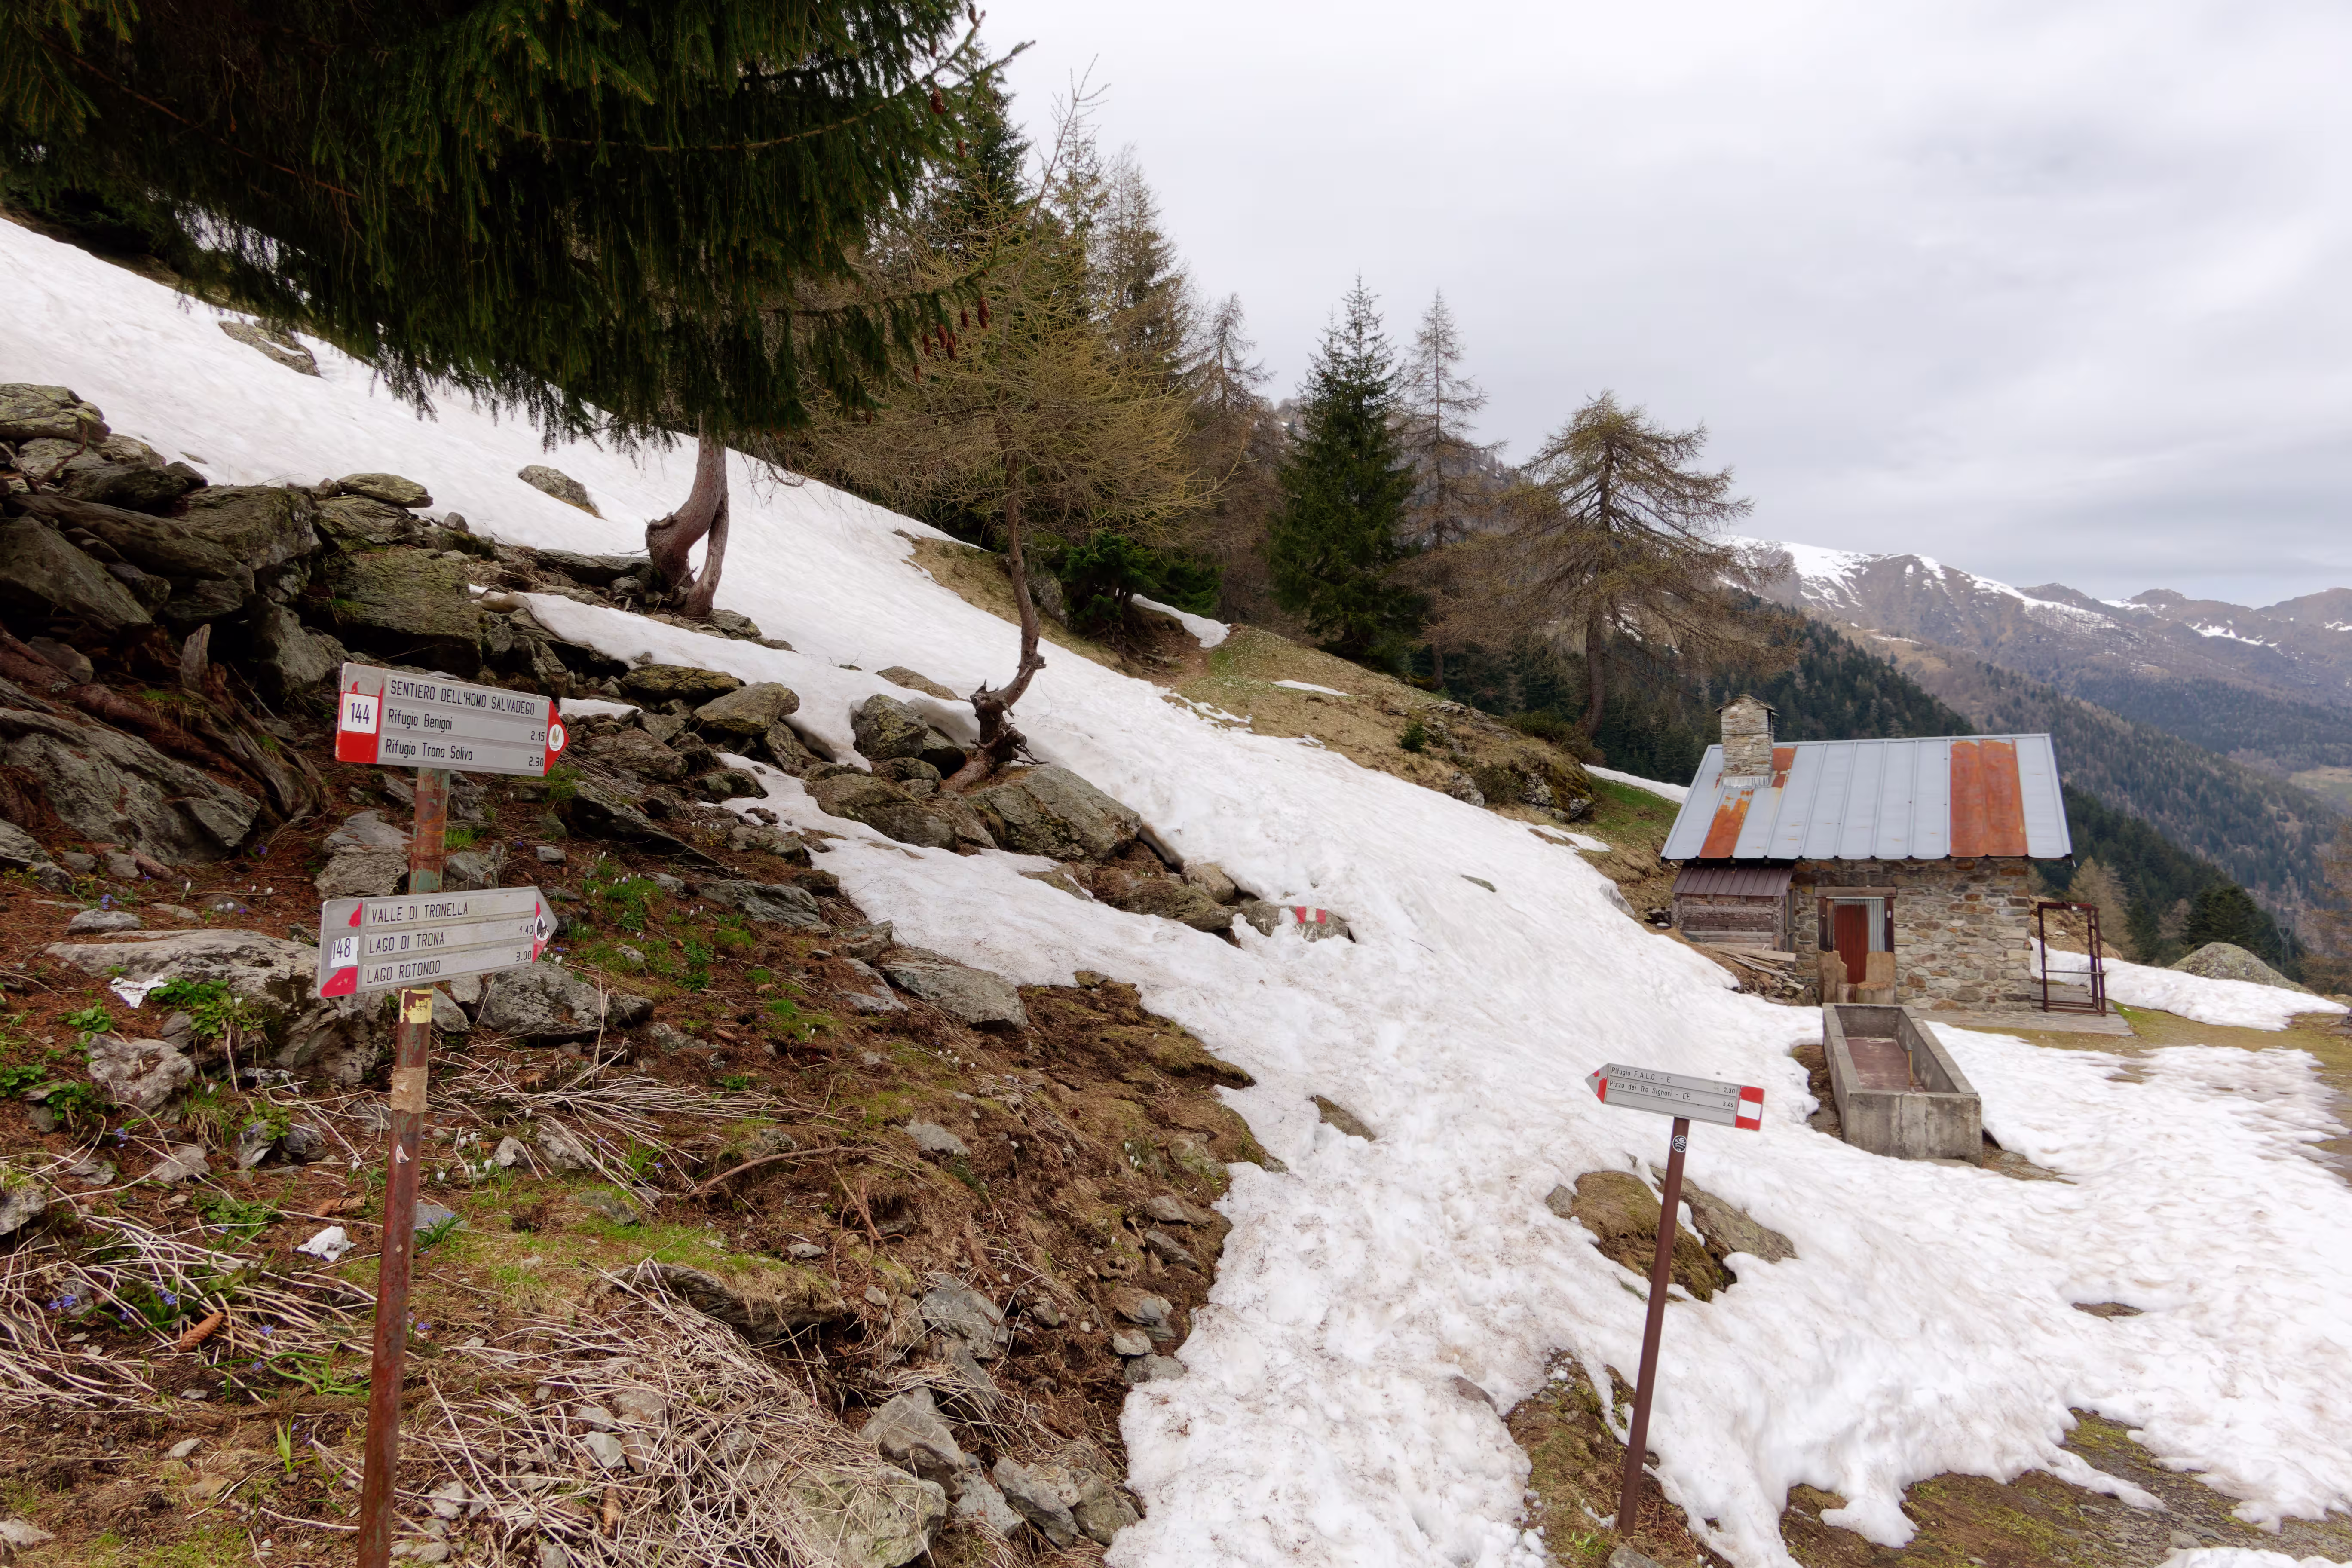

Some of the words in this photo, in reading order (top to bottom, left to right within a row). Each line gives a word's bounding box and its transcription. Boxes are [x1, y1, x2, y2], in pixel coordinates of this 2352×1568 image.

[391, 680, 435, 700] SENTIERO
[441, 688, 486, 708] DELL'HOMO
[491, 696, 535, 715] SALVADEGO
[351, 703, 370, 724] 144
[388, 708, 418, 729] Rifugio
[424, 713, 452, 732] Benigni
[531, 731, 545, 741] 2.15
[386, 738, 416, 758] Rifugio
[423, 742, 445, 758] Trona
[450, 745, 472, 760] Soliva
[529, 756, 544, 767] 2.30
[372, 906, 403, 923] VALLE
[409, 906, 417, 920] DI
[424, 902, 468, 918] TRONELLA
[332, 938, 351, 959] 148
[369, 937, 395, 953] LAGO
[401, 935, 410, 949] DI
[416, 932, 444, 948] TRONA
[519, 925, 533, 935] 1.40
[367, 967, 392, 984] LAGO
[399, 960, 441, 979] ROTONDO
[516, 950, 532, 962] 3.00
[1611, 1067, 1631, 1077] Rifugio
[1634, 1071, 1656, 1081] F.A.L.C.
[1609, 1080, 1624, 1089] Pizzo
[1652, 1087, 1672, 1097] Signori
